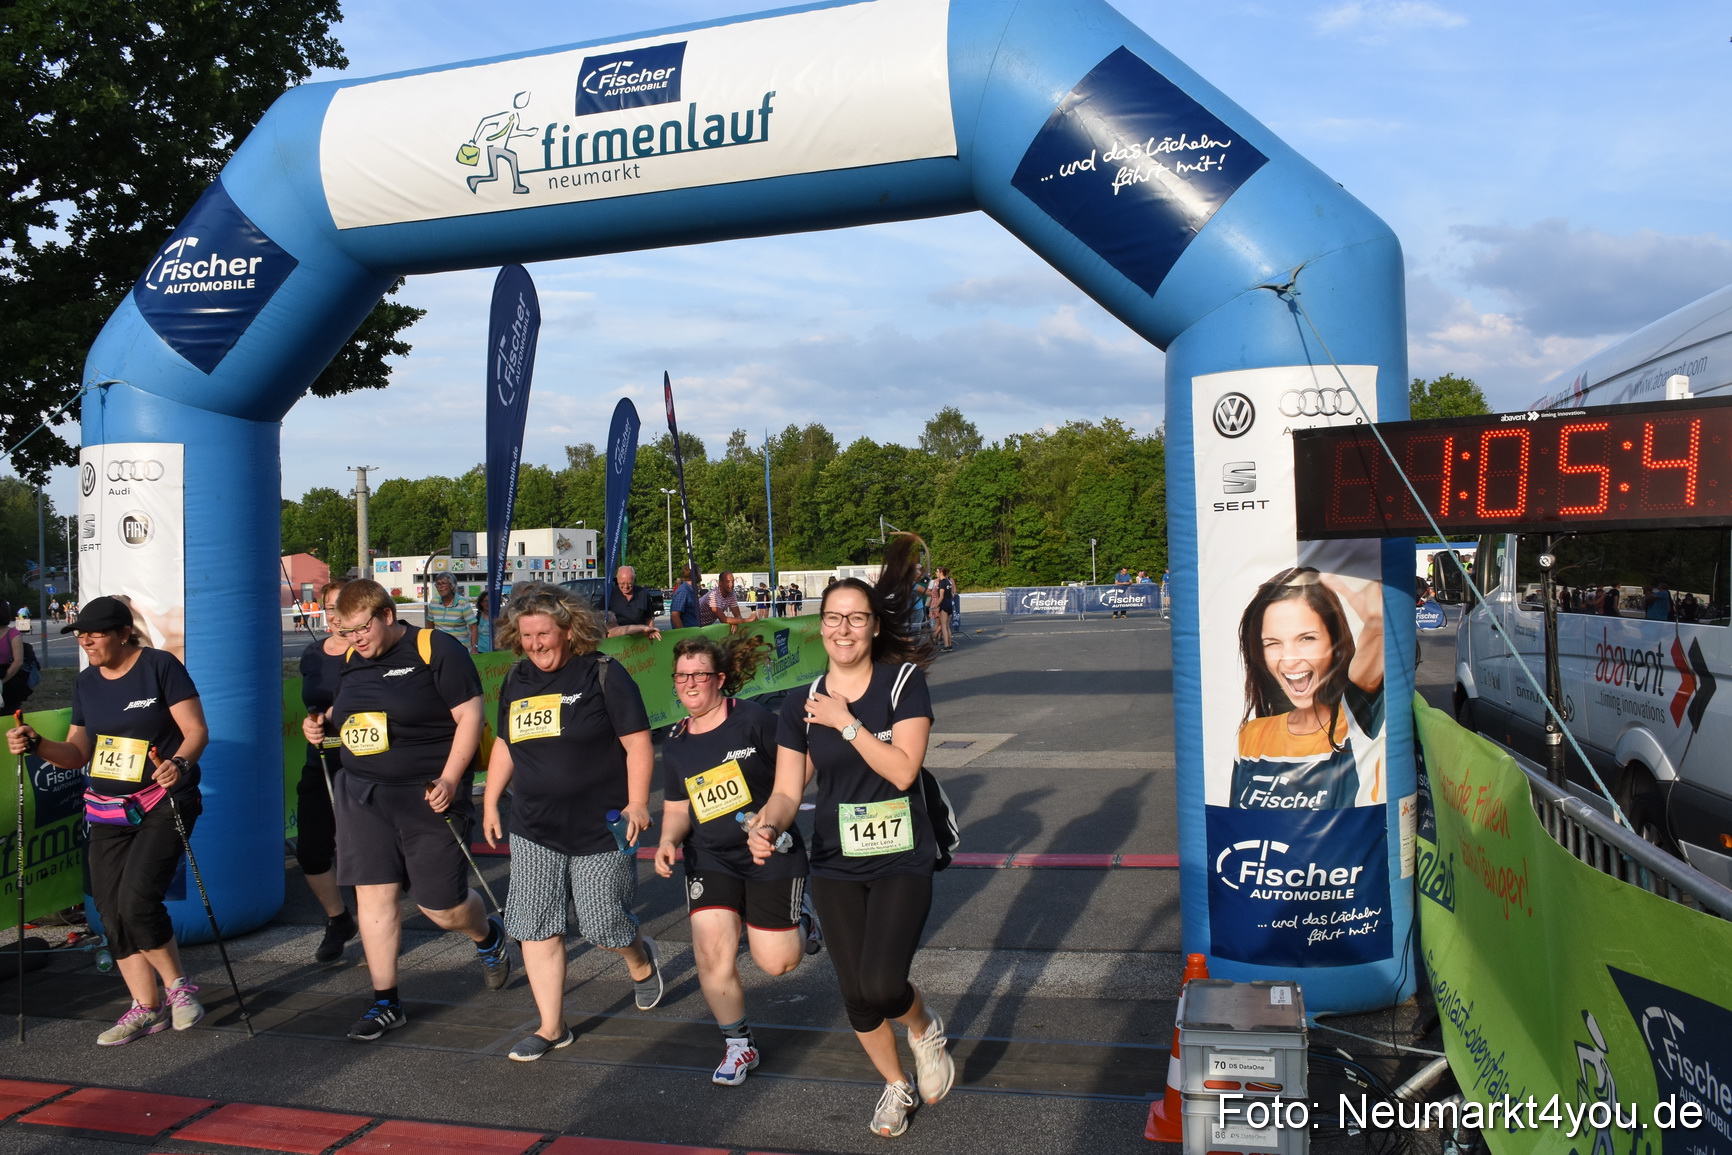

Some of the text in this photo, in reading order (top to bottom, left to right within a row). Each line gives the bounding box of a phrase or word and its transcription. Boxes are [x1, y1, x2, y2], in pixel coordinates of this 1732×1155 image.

[597, 64, 676, 90] Fischer
[604, 80, 668, 98] AUTOMOBILE
[541, 91, 776, 170] firmenlauf
[1103, 141, 1142, 163] das
[548, 164, 642, 190] neumarkt
[1111, 153, 1227, 196] fährt mit!
[159, 255, 263, 283] Fischer
[164, 279, 256, 295] AUTOMOBILE
[503, 291, 528, 388] Fischer
[515, 309, 531, 386] AUTOMOBILE
[1500, 412, 1527, 422] abavent
[108, 487, 131, 496] Audi
[1213, 499, 1270, 512] SEAT
[494, 445, 520, 592] www.fischer-automobile.de
[125, 521, 146, 538] FIAT
[1030, 597, 1069, 607] Fischer
[1108, 594, 1147, 605] Fischer
[1415, 612, 1440, 620] Fischer
[1595, 626, 1665, 697] abavent
[515, 709, 552, 730] 1458
[1622, 697, 1666, 724] innovations
[344, 727, 380, 745] 1378
[99, 750, 135, 770] 1451
[697, 780, 739, 807] 1400
[849, 818, 902, 842] 1417
[1239, 859, 1364, 887] Fischer
[1249, 888, 1355, 901] AUTOMOBILE
[1302, 911, 1328, 926] das
[1307, 919, 1379, 946] fährt mit!
[1213, 1060, 1227, 1071] 70
[1239, 1062, 1265, 1071] DataOne
[1662, 1036, 1732, 1114] Fische
[1215, 1131, 1226, 1139] 86
